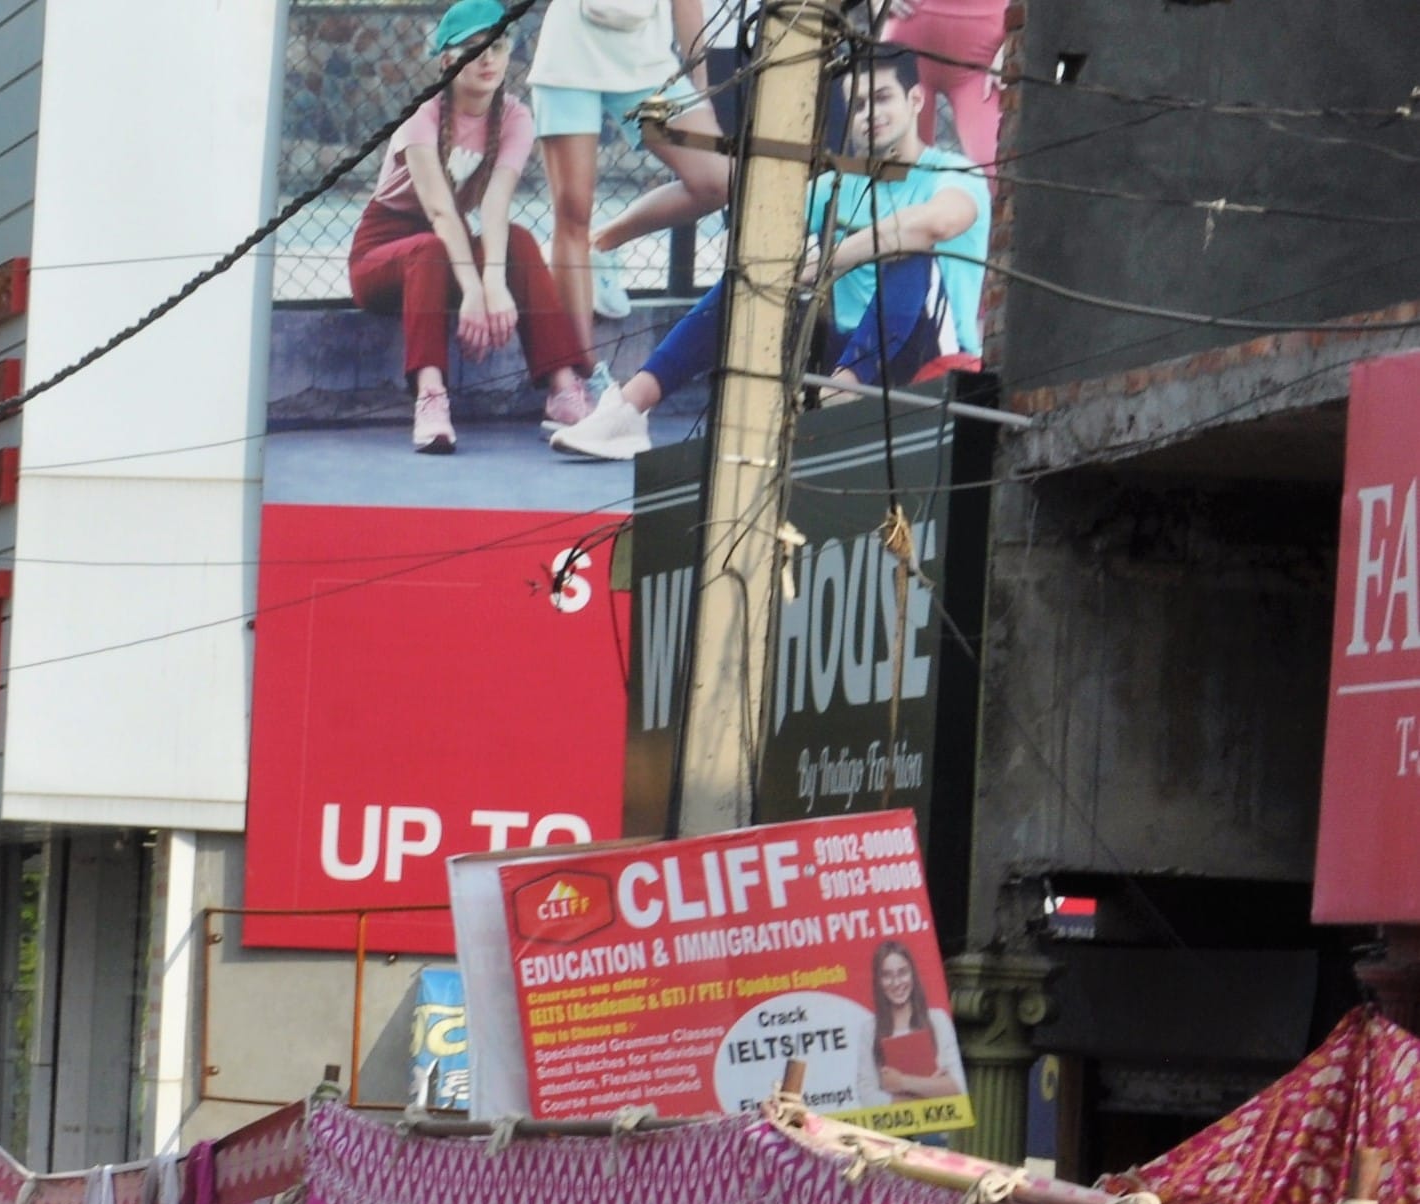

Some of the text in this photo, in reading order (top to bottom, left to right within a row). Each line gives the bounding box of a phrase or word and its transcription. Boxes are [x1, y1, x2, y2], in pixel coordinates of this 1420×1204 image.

[319, 802, 442, 882] UP
[616, 839, 801, 929] CLIFF
[535, 897, 593, 921] CLIFF
[518, 901, 929, 987] EDUCATION & IMMIGRATION PVT. LTD.
[526, 985, 586, 1005] Courses
[528, 1003, 566, 1026] IELTS
[566, 992, 646, 1021] (Academic
[790, 963, 848, 990] English
[756, 1004, 808, 1030] Crack
[533, 1023, 725, 1066] Specialized Grammar Classes
[535, 1041, 715, 1080] Small batches for individual
[726, 1026, 849, 1066] IELTS/PTE
[600, 1067, 653, 1088] Flexible
[653, 1061, 698, 1083] timing
[539, 1076, 702, 1114] Course material included
